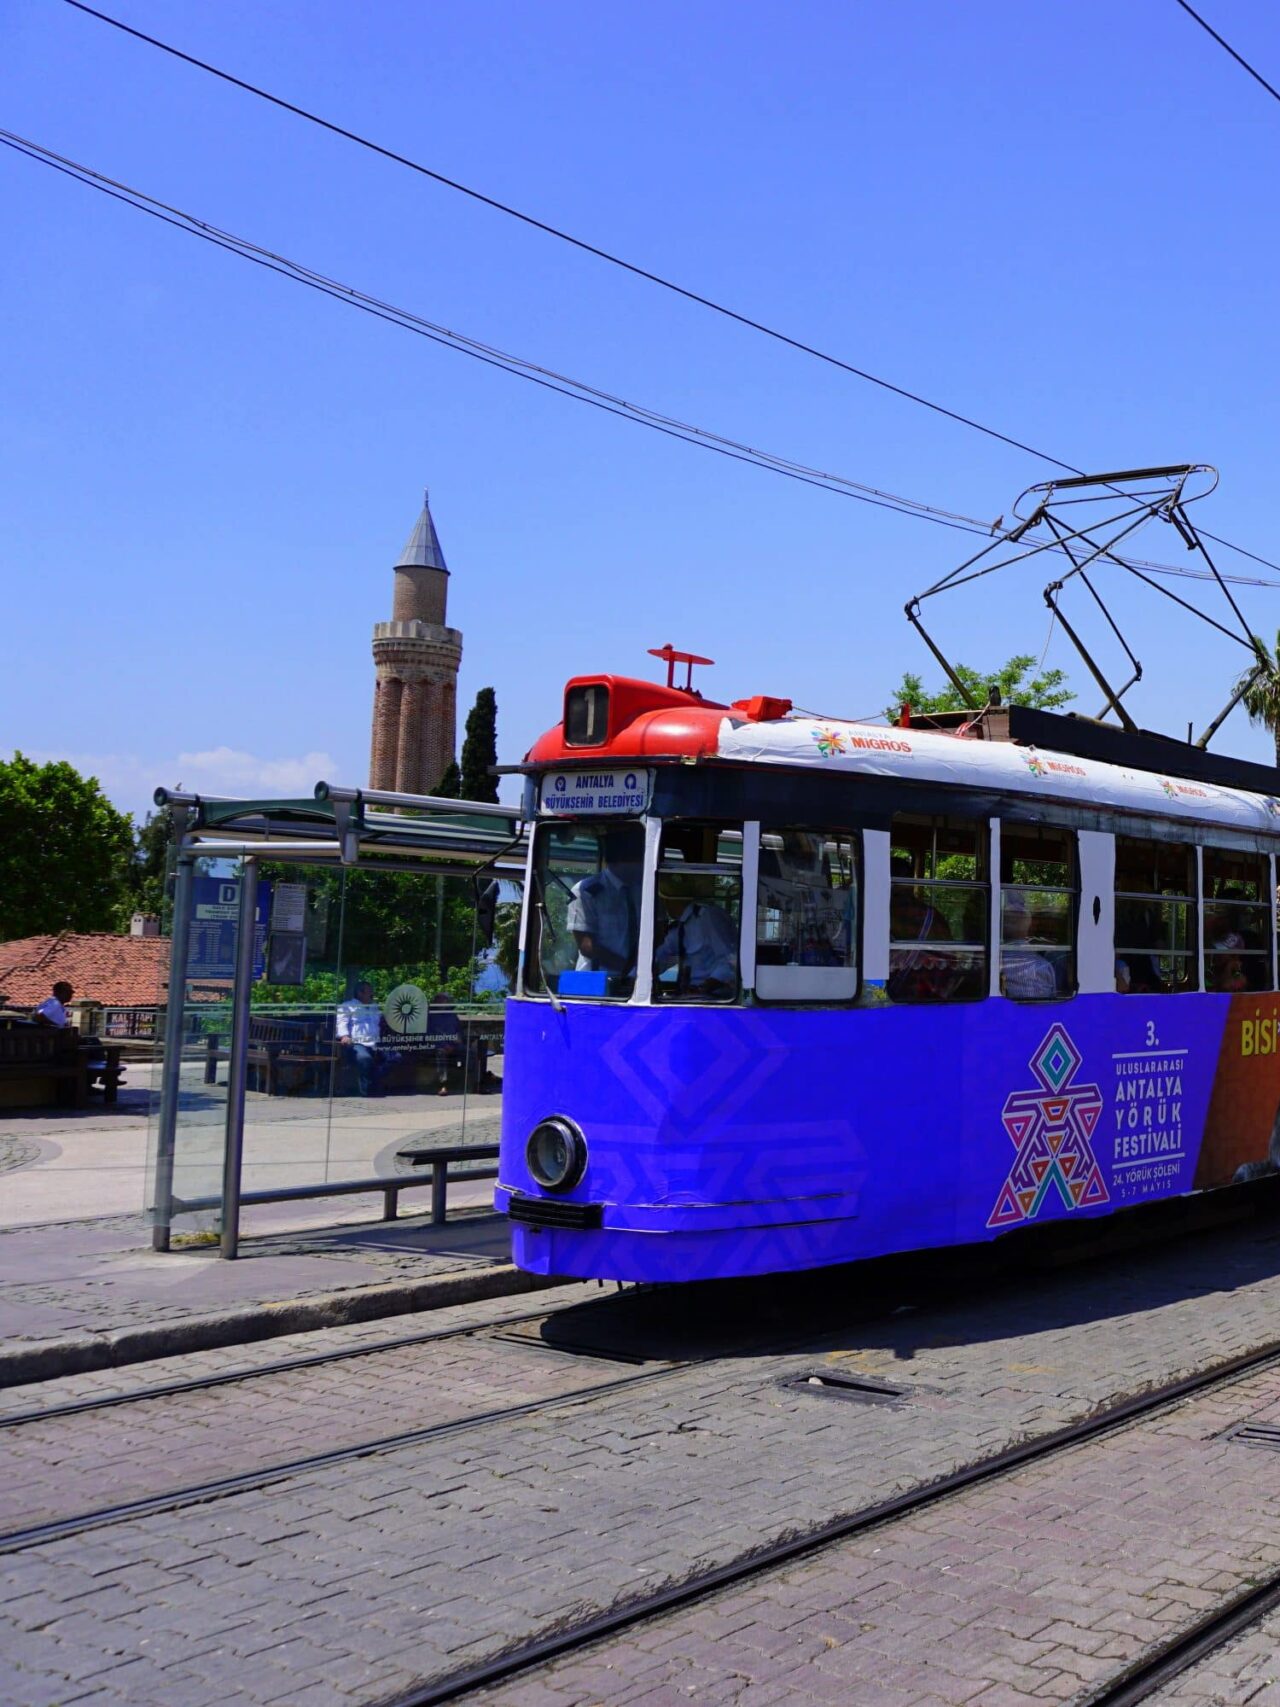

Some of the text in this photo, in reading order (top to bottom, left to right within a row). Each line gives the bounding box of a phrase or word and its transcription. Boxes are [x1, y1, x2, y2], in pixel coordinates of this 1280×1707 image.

[575, 774, 615, 789] ANTALYA
[598, 791, 644, 808] BELEDİYESİ
[1145, 1020, 1160, 1047] 3.
[1116, 1058, 1184, 1076] ULUSLARARASI
[1115, 1076, 1182, 1102] ANTALYA
[1115, 1098, 1181, 1130] YÖRÜK
[1114, 1123, 1181, 1159] FESTİVALİ
[1126, 1167, 1152, 1183] YÖRÜK
[1153, 1160, 1180, 1182] ŞÖLENİ
